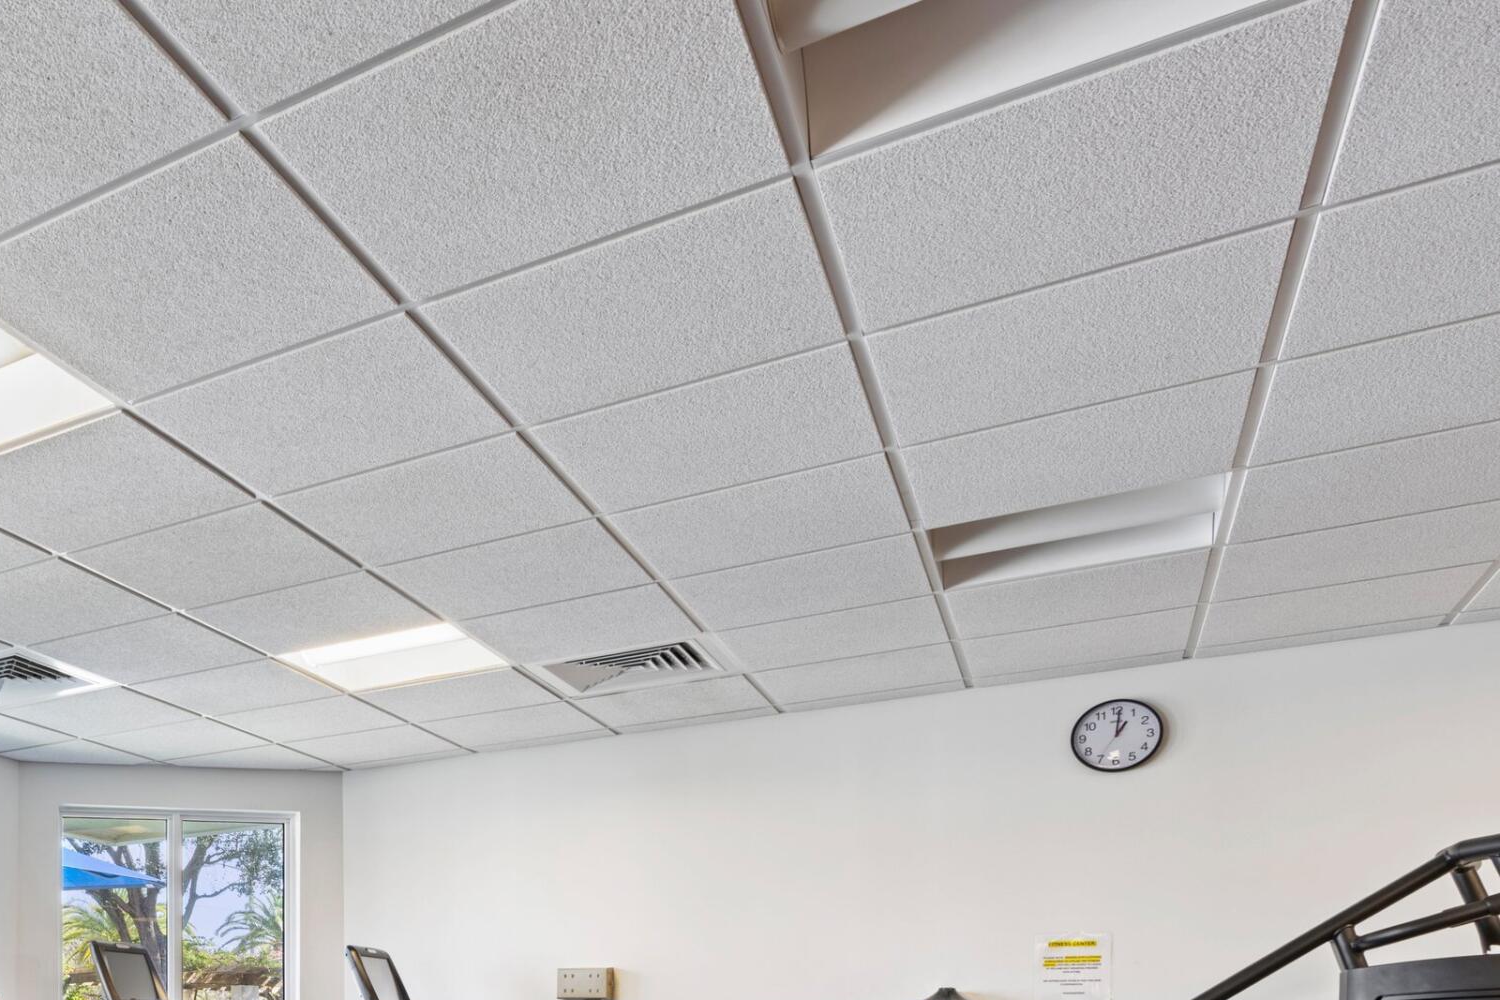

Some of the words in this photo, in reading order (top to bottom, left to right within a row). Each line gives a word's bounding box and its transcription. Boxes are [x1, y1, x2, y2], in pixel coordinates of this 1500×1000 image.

[1095, 711, 1106, 721] 11
[1111, 706, 1123, 716] 12
[1131, 708, 1136, 717] 1
[1141, 715, 1150, 725] 2
[1084, 722, 1097, 732] 10
[1146, 728, 1155, 738] 3
[1078, 735, 1087, 743] 9
[1140, 742, 1148, 750] 4
[1084, 747, 1093, 757] 8
[1128, 752, 1137, 761] 5
[1097, 754, 1105, 764] 7
[1112, 756, 1120, 765] 6
